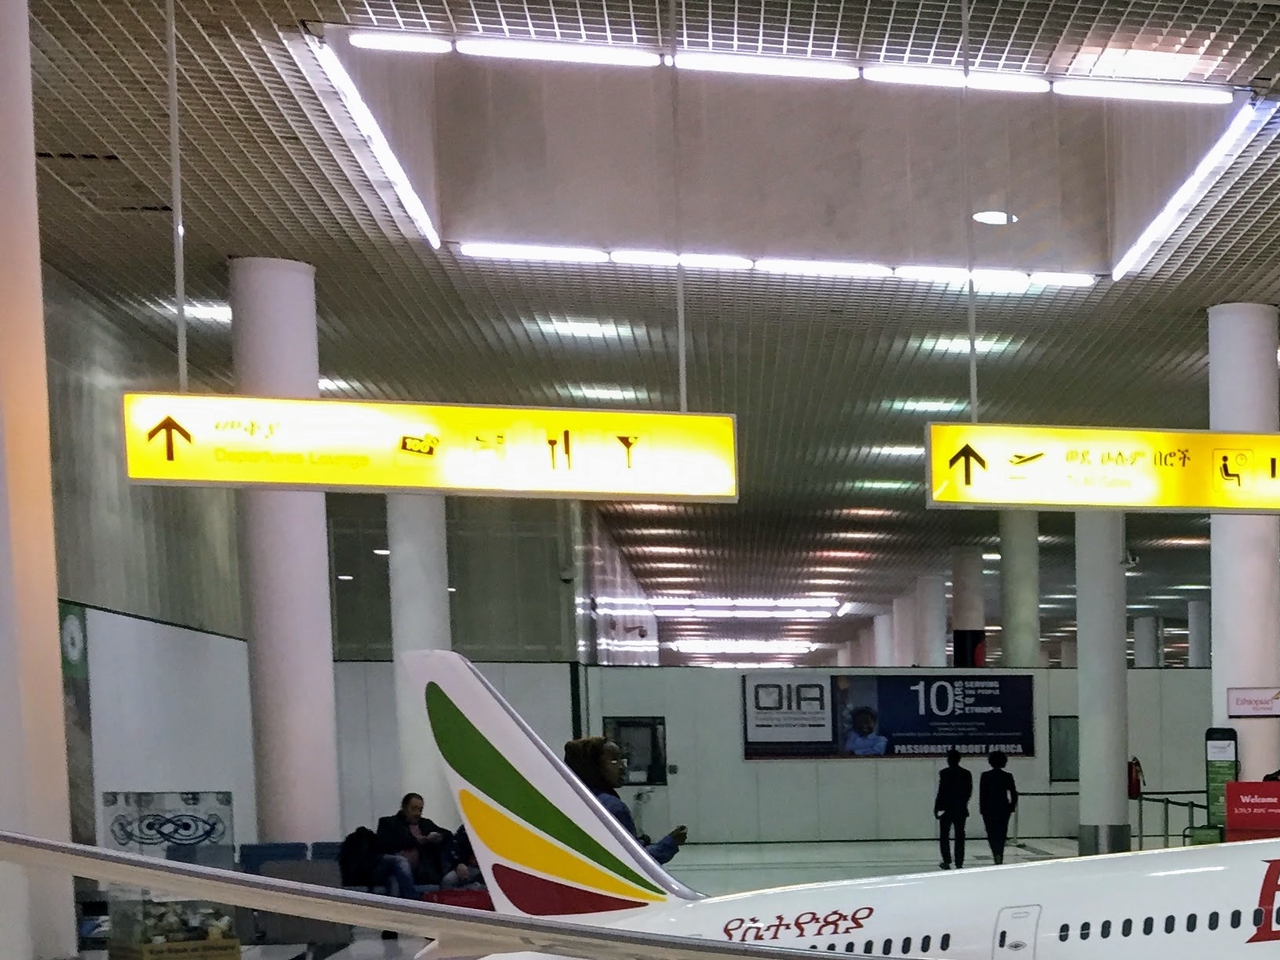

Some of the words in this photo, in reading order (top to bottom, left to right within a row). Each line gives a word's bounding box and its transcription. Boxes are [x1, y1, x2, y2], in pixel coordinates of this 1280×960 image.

[1153, 448, 1192, 468] በሮች
[964, 680, 1000, 688] SERVING
[909, 680, 954, 717] 10
[954, 681, 964, 715] YEARS
[1240, 794, 1279, 804] Welcome
